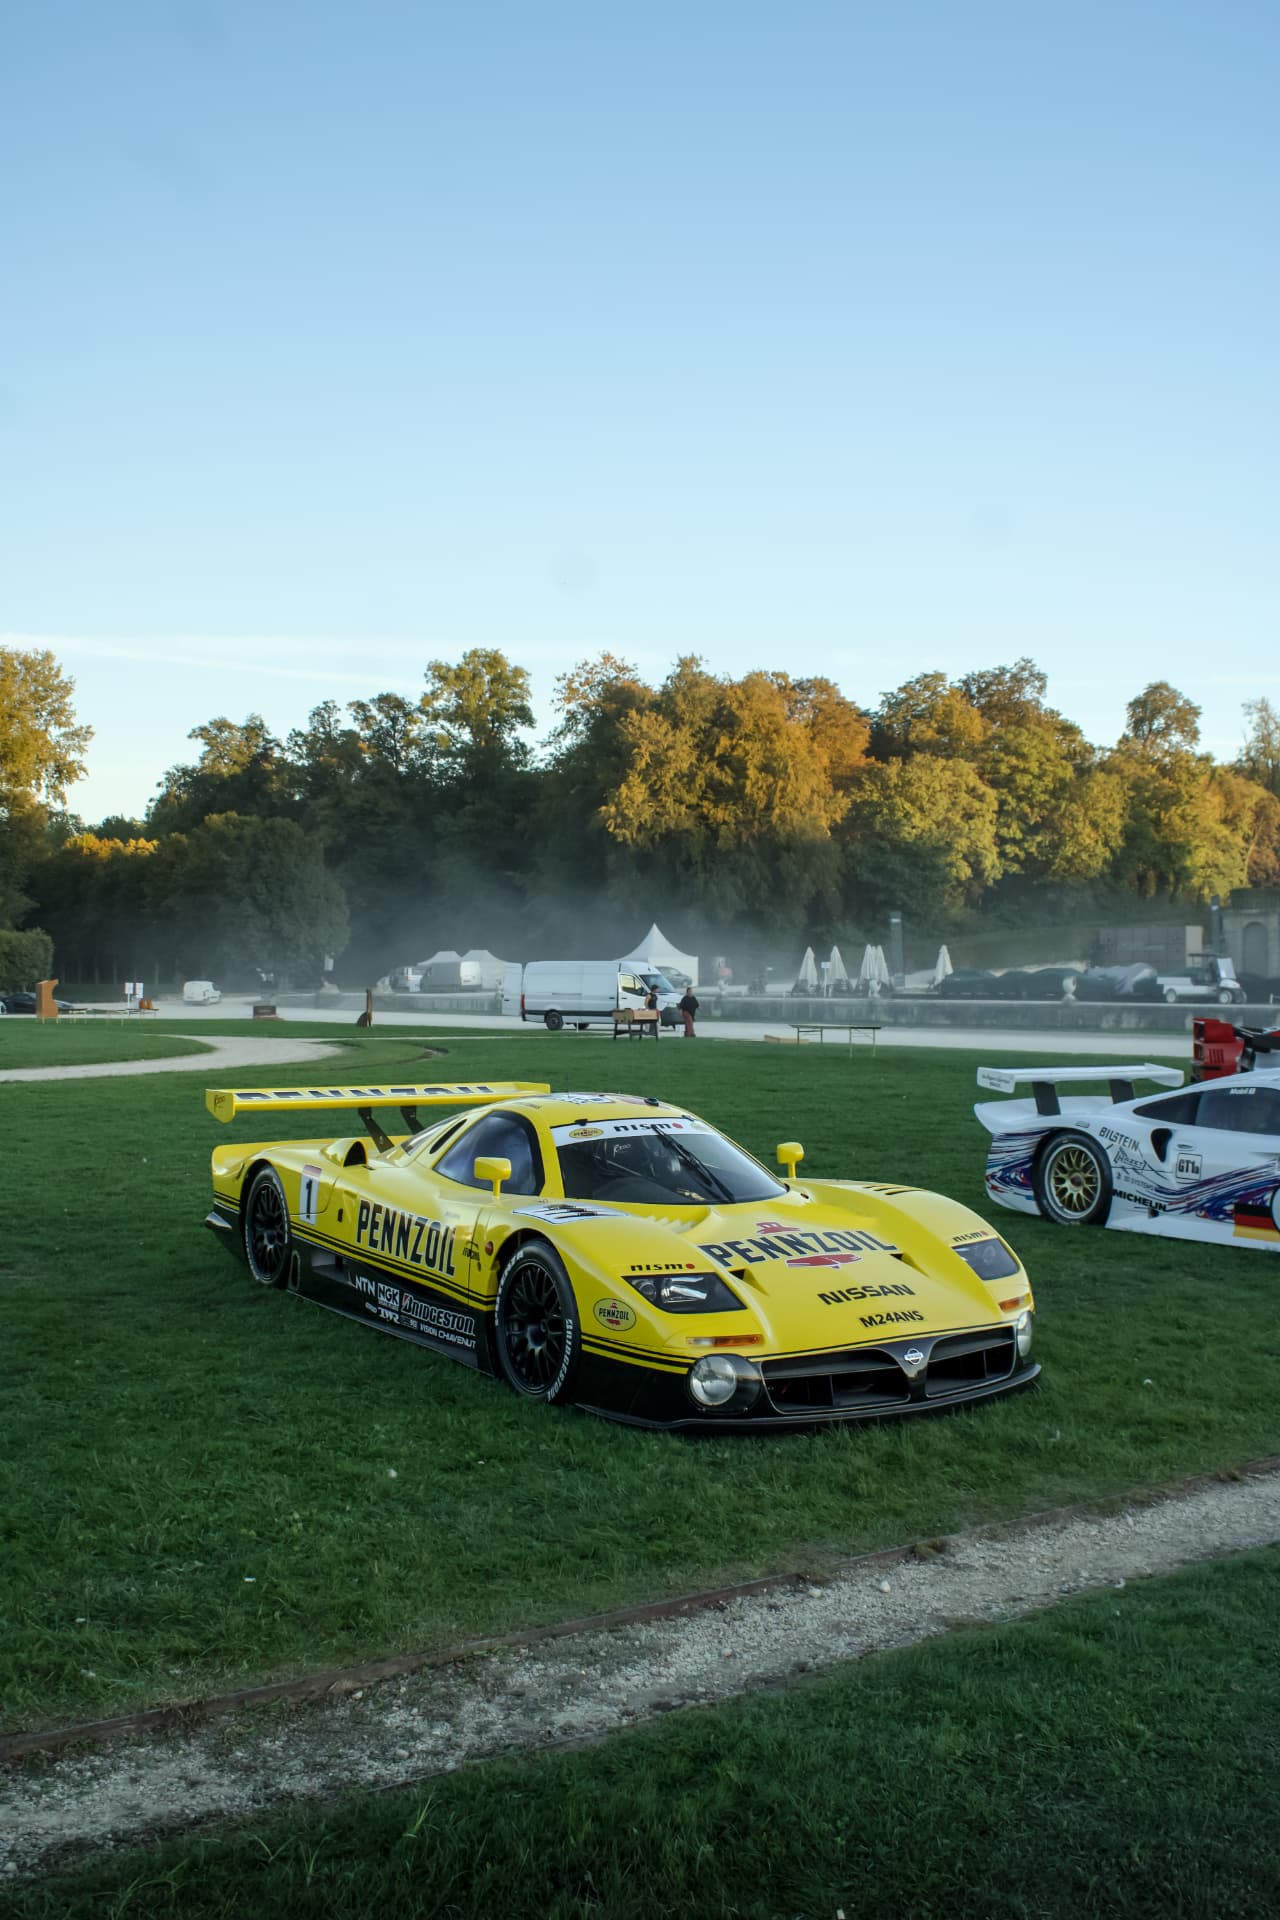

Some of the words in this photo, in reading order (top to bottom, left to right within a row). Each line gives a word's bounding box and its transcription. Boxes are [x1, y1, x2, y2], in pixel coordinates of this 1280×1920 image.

[1098, 1126, 1140, 1151] BILSTEIN
[305, 1179, 314, 1219] 1
[1112, 1188, 1167, 1212] MICHELIN
[356, 1199, 457, 1278] PENNZOIL
[697, 1230, 898, 1268] PENNZOIL
[355, 1275, 376, 1296] NTN
[378, 1284, 399, 1307] NGK
[817, 1284, 917, 1306] NISSAN
[598, 1308, 629, 1321] PENNZOIL
[859, 1310, 925, 1328] M24ANS
